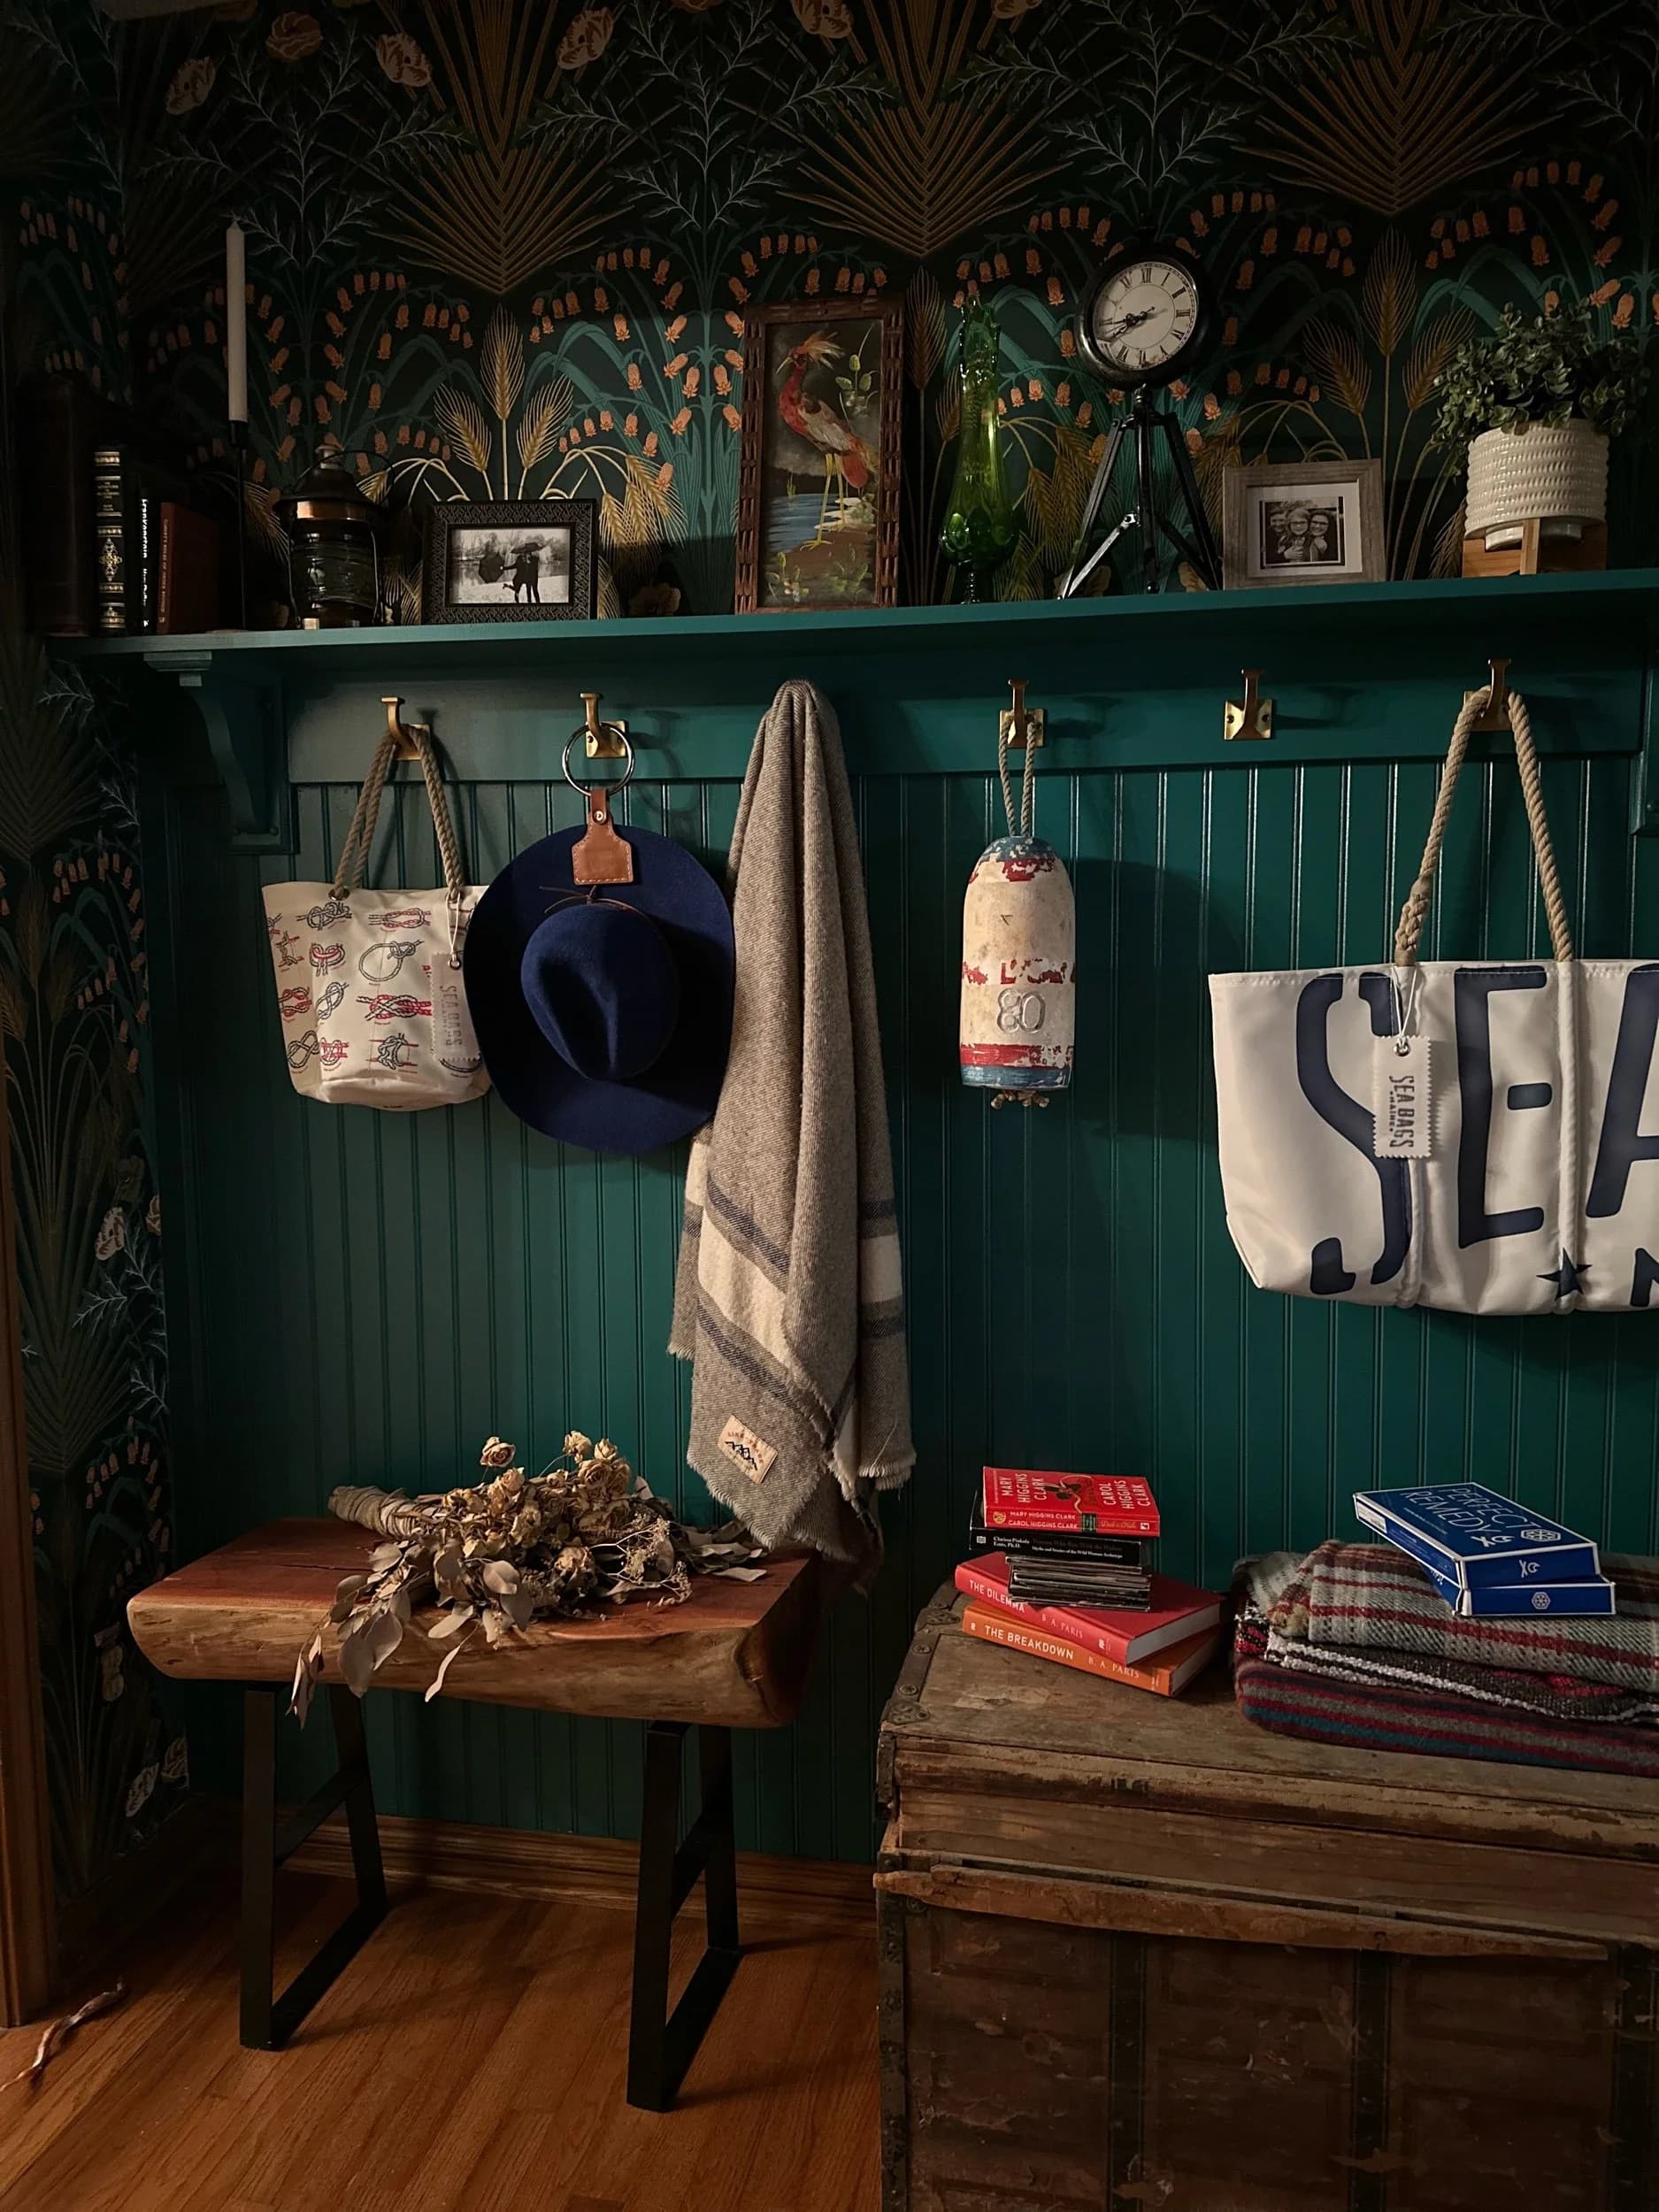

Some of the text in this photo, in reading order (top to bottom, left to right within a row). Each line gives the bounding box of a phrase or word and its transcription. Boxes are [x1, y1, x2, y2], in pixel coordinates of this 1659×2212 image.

[996, 987, 1047, 1034] 80
[1389, 1075, 1415, 1148] SEA BAGS
[1000, 1476, 1013, 1495] MARY
[1015, 1472, 1032, 1503] HIGGINS
[1032, 1478, 1048, 1501] CLARK
[1098, 1482, 1118, 1506] CAROL
[1113, 1479, 1136, 1509] HIGGINS
[1131, 1483, 1151, 1507] CLARK
[1400, 1491, 1502, 1532] REMEDY
[1439, 1487, 1541, 1528] PERFECT
[1030, 1520, 1056, 1529] HIGGINS
[969, 1579, 1025, 1613] THE DILEMMA
[985, 1624, 1074, 1660] THE BREAKDOWN
[1061, 1623, 1084, 1640] PARIS
[1112, 1663, 1141, 1678] PARIS
